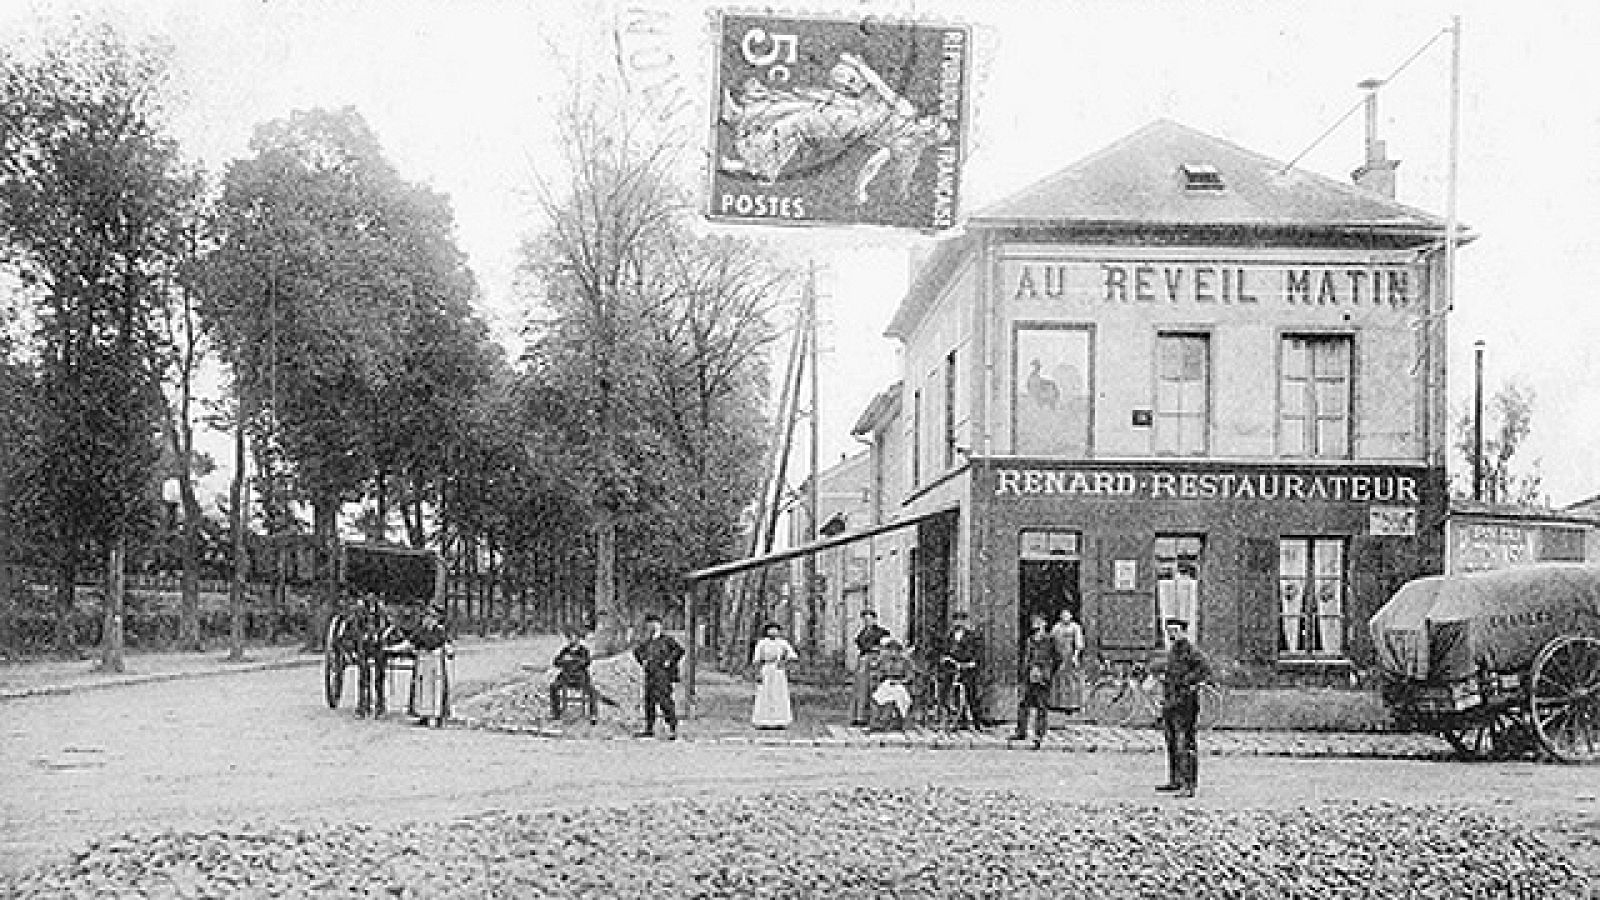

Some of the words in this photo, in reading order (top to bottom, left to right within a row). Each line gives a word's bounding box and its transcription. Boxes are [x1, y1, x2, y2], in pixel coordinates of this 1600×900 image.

[720, 194, 804, 219] POSTES
[1014, 266, 1065, 300] AU
[1286, 268, 1412, 308] MATIN
